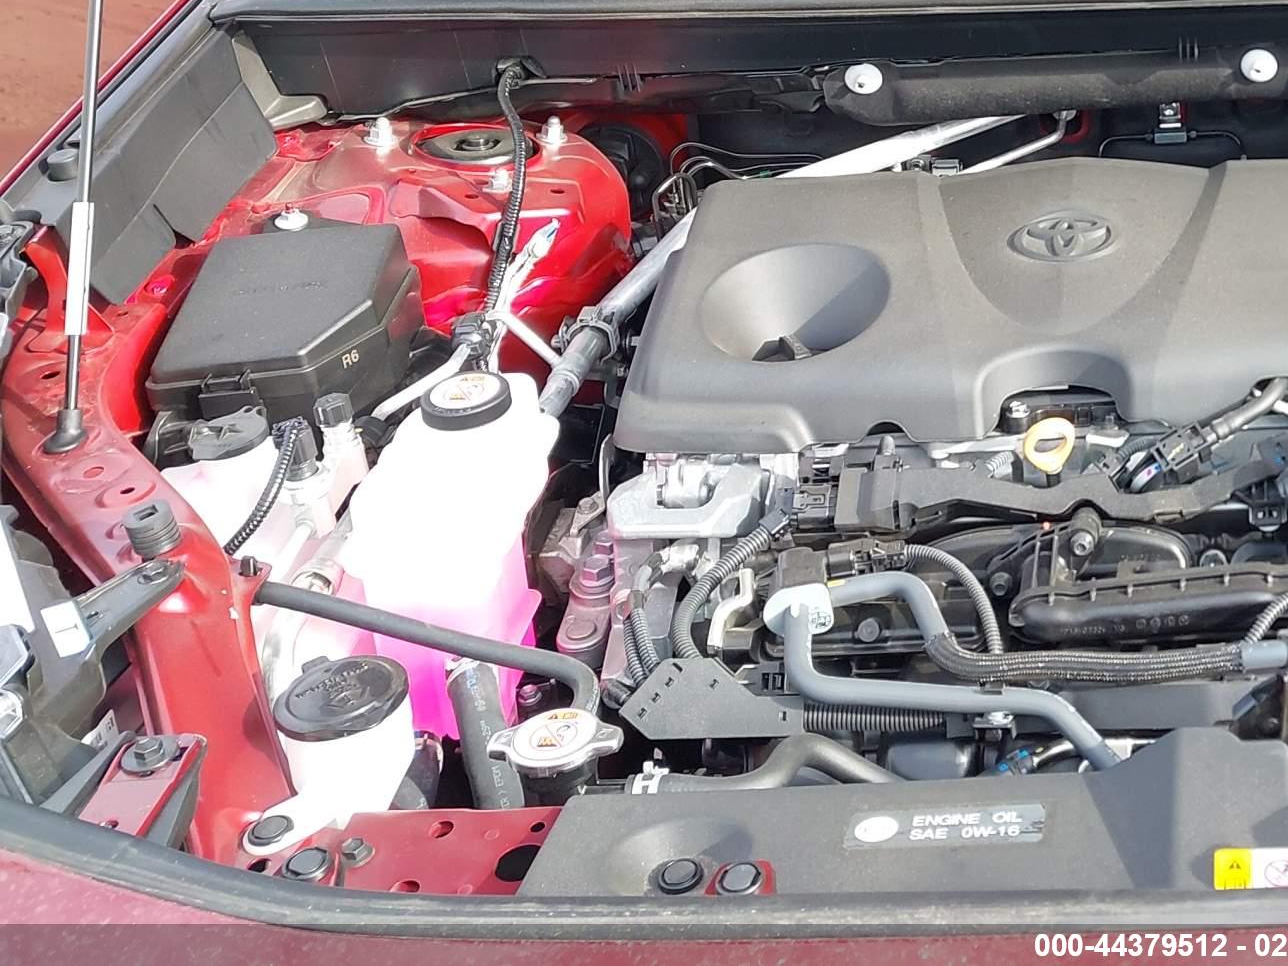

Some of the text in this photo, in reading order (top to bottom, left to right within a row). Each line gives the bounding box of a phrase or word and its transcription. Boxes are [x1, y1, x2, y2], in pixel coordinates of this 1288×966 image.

[342, 349, 360, 370] R6
[913, 811, 1022, 827] ENGINE OIL
[909, 825, 1020, 840] SAE 0W-16
